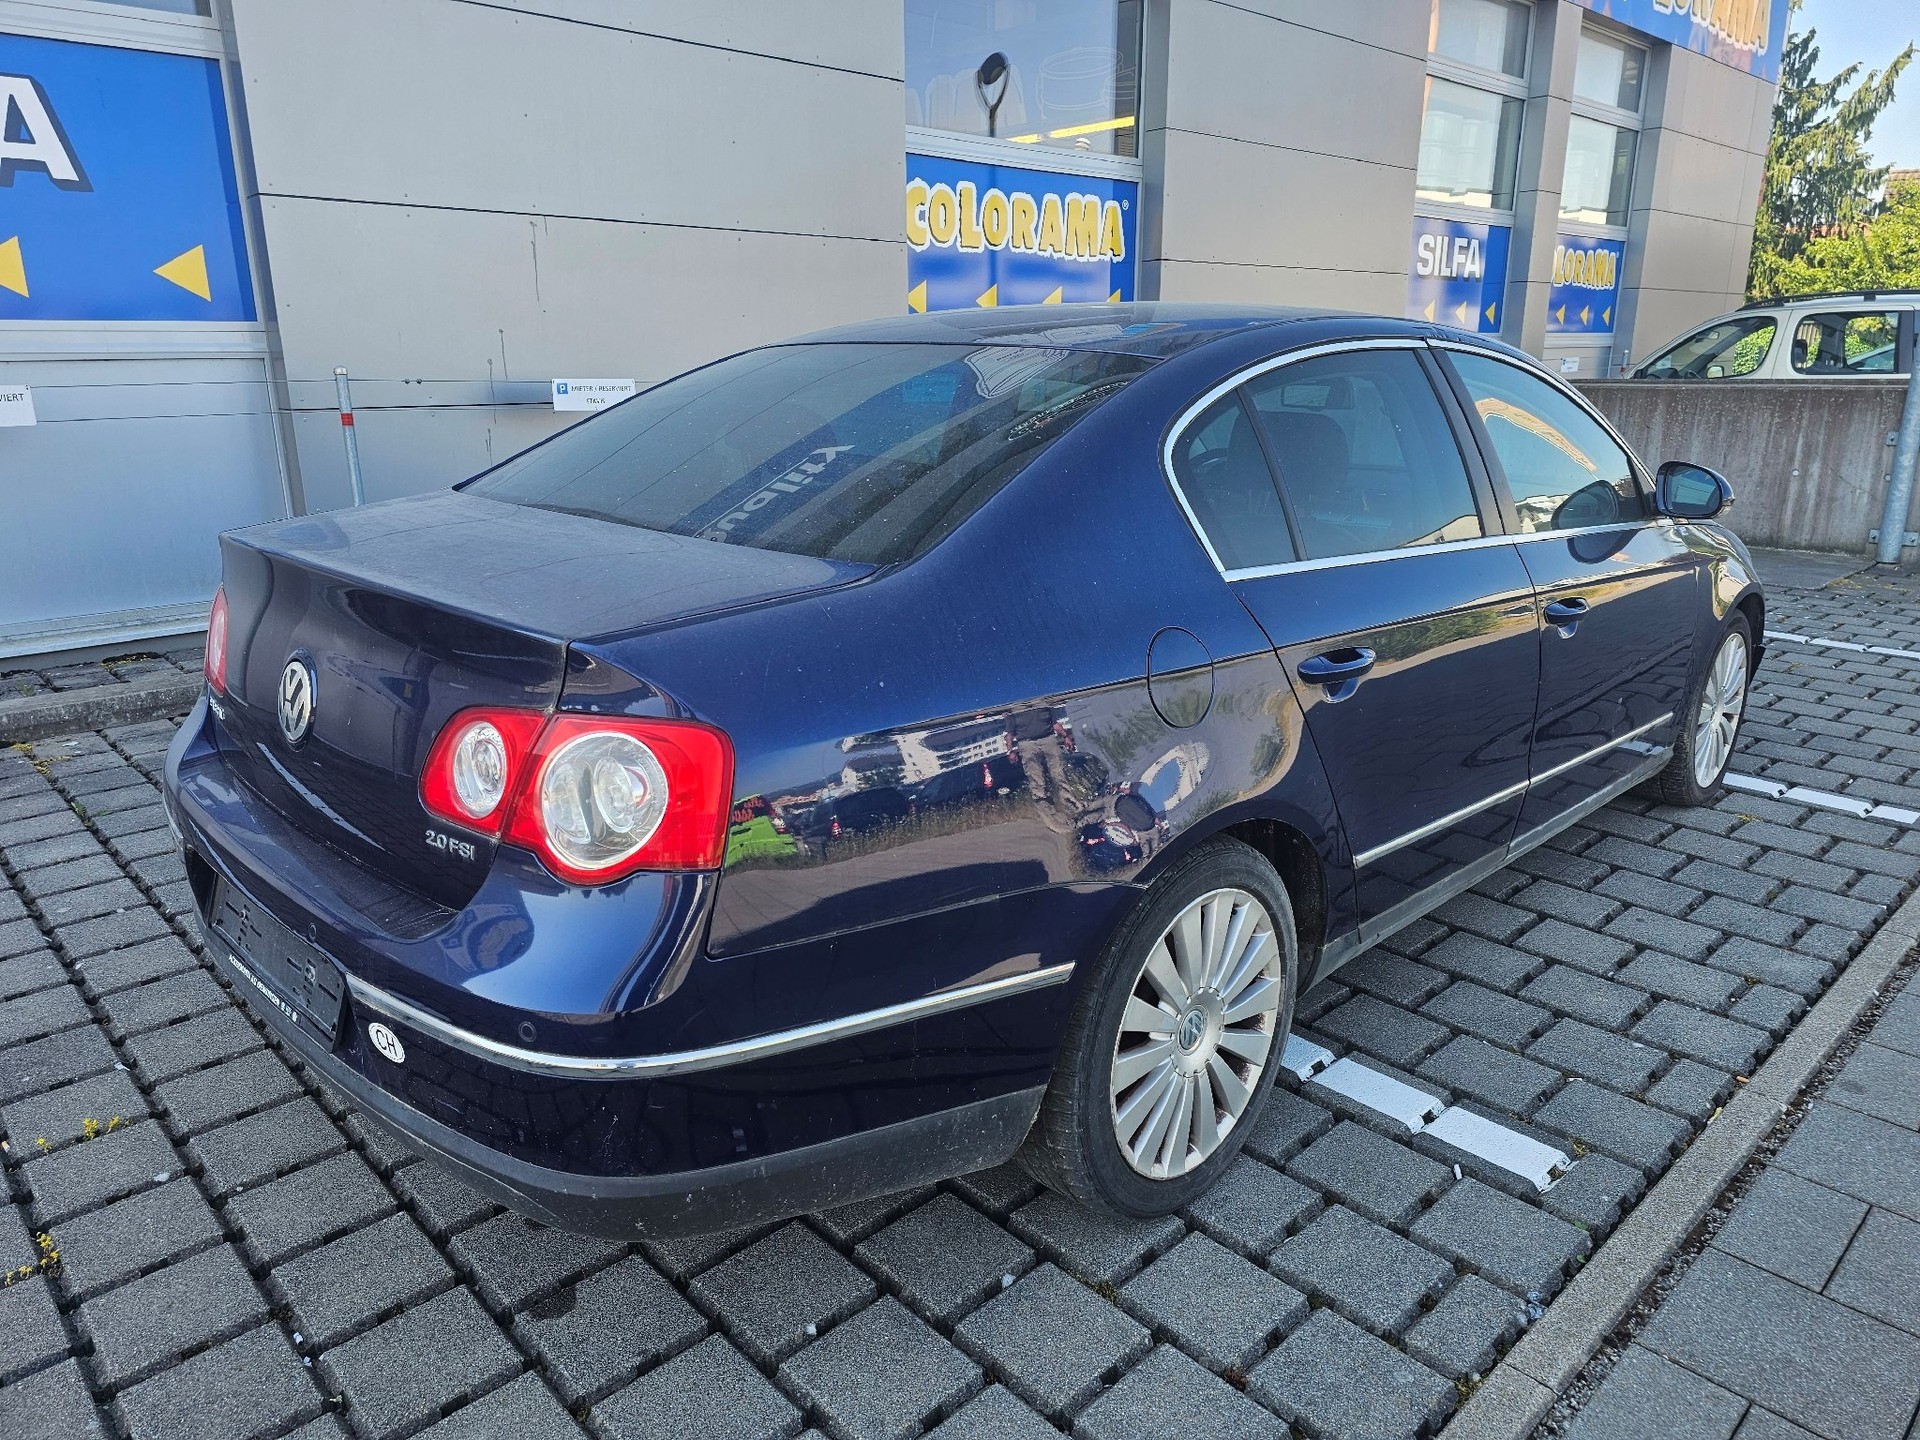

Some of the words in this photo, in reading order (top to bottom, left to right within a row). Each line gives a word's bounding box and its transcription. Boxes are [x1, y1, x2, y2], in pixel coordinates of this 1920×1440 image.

[1417, 233, 1482, 280] SILFA
[1552, 245, 1616, 291] LORAMA
[449, 837, 475, 860] FSI
[375, 1029, 398, 1057] CH
